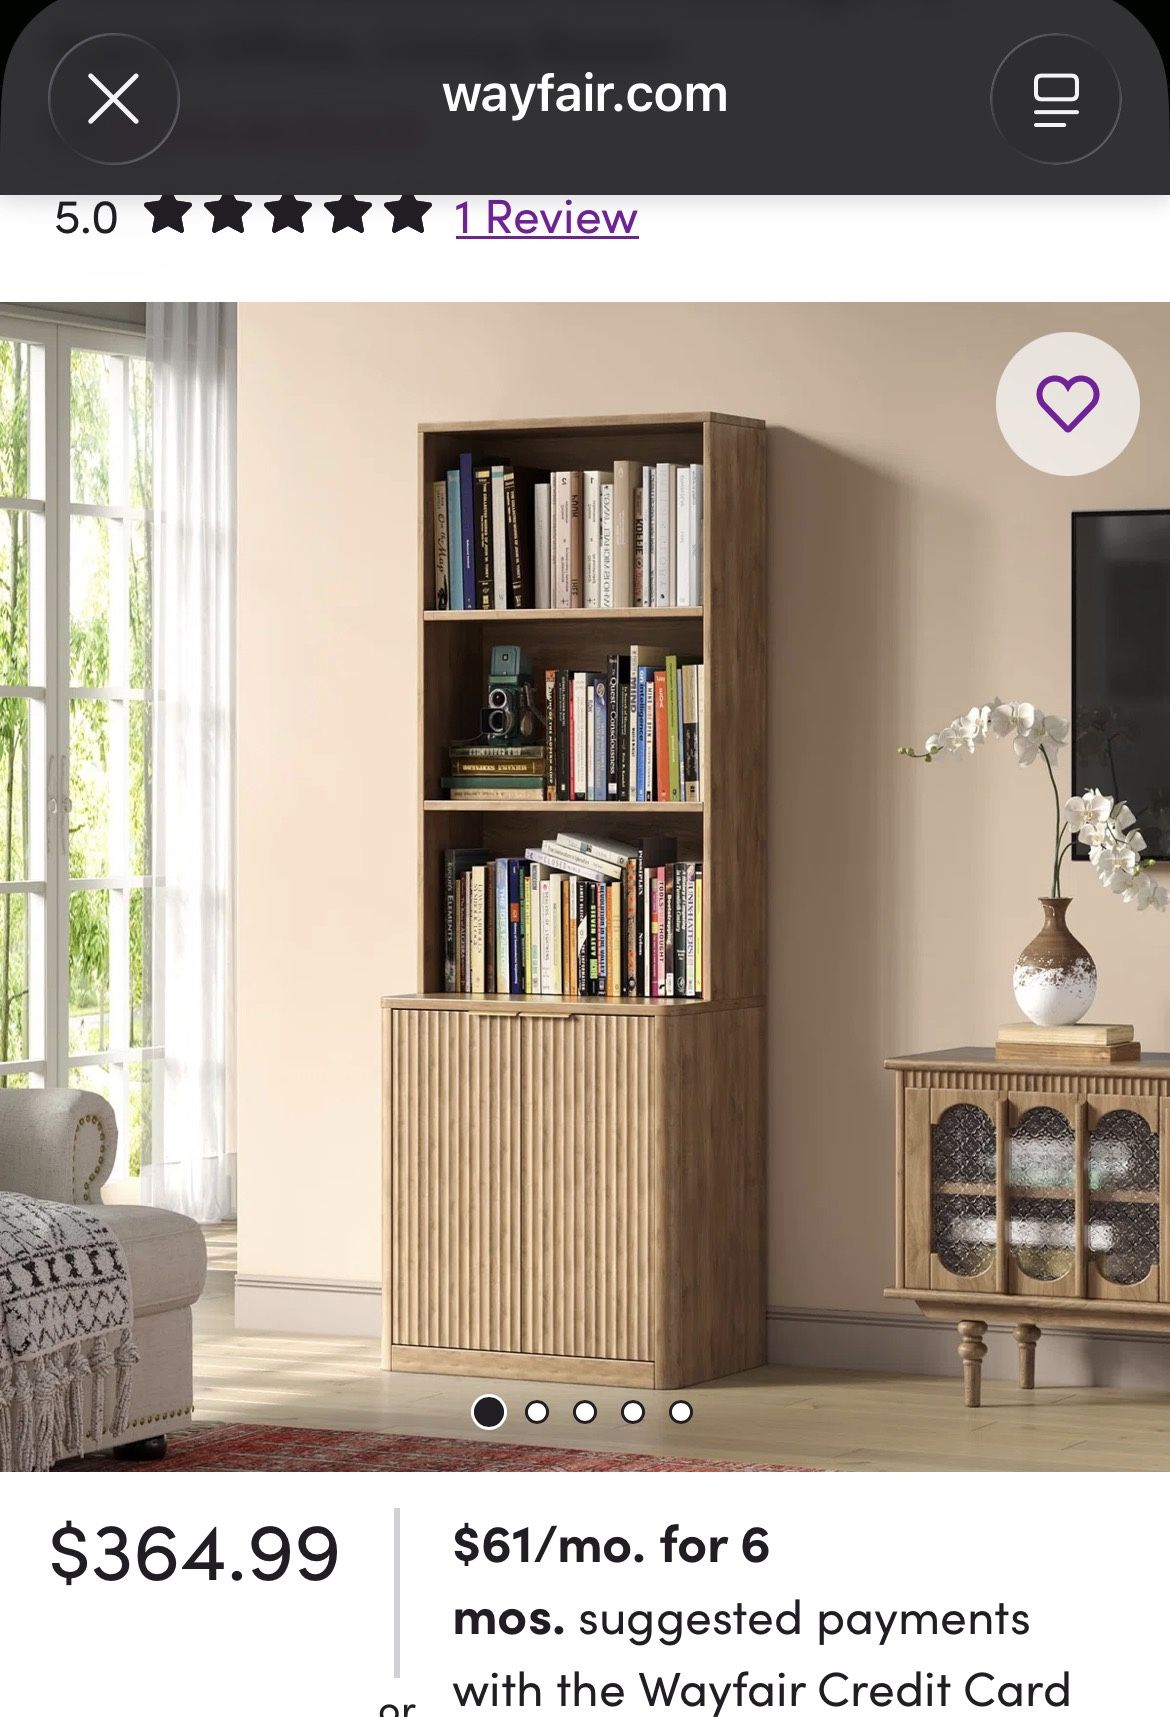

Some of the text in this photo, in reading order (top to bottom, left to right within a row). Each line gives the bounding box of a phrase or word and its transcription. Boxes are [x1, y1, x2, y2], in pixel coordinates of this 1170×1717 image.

[443, 72, 728, 121] wayfair.com
[56, 201, 117, 234] 5.0
[456, 200, 638, 234] 1 Review
[640, 670, 644, 682] on
[52, 1521, 338, 1585] $364.99
[455, 1523, 769, 1566] $61/mo. for 6
[455, 1599, 1030, 1646] mos. suggested payments
[453, 1671, 1070, 1717] with the Wayfair Credit Card
